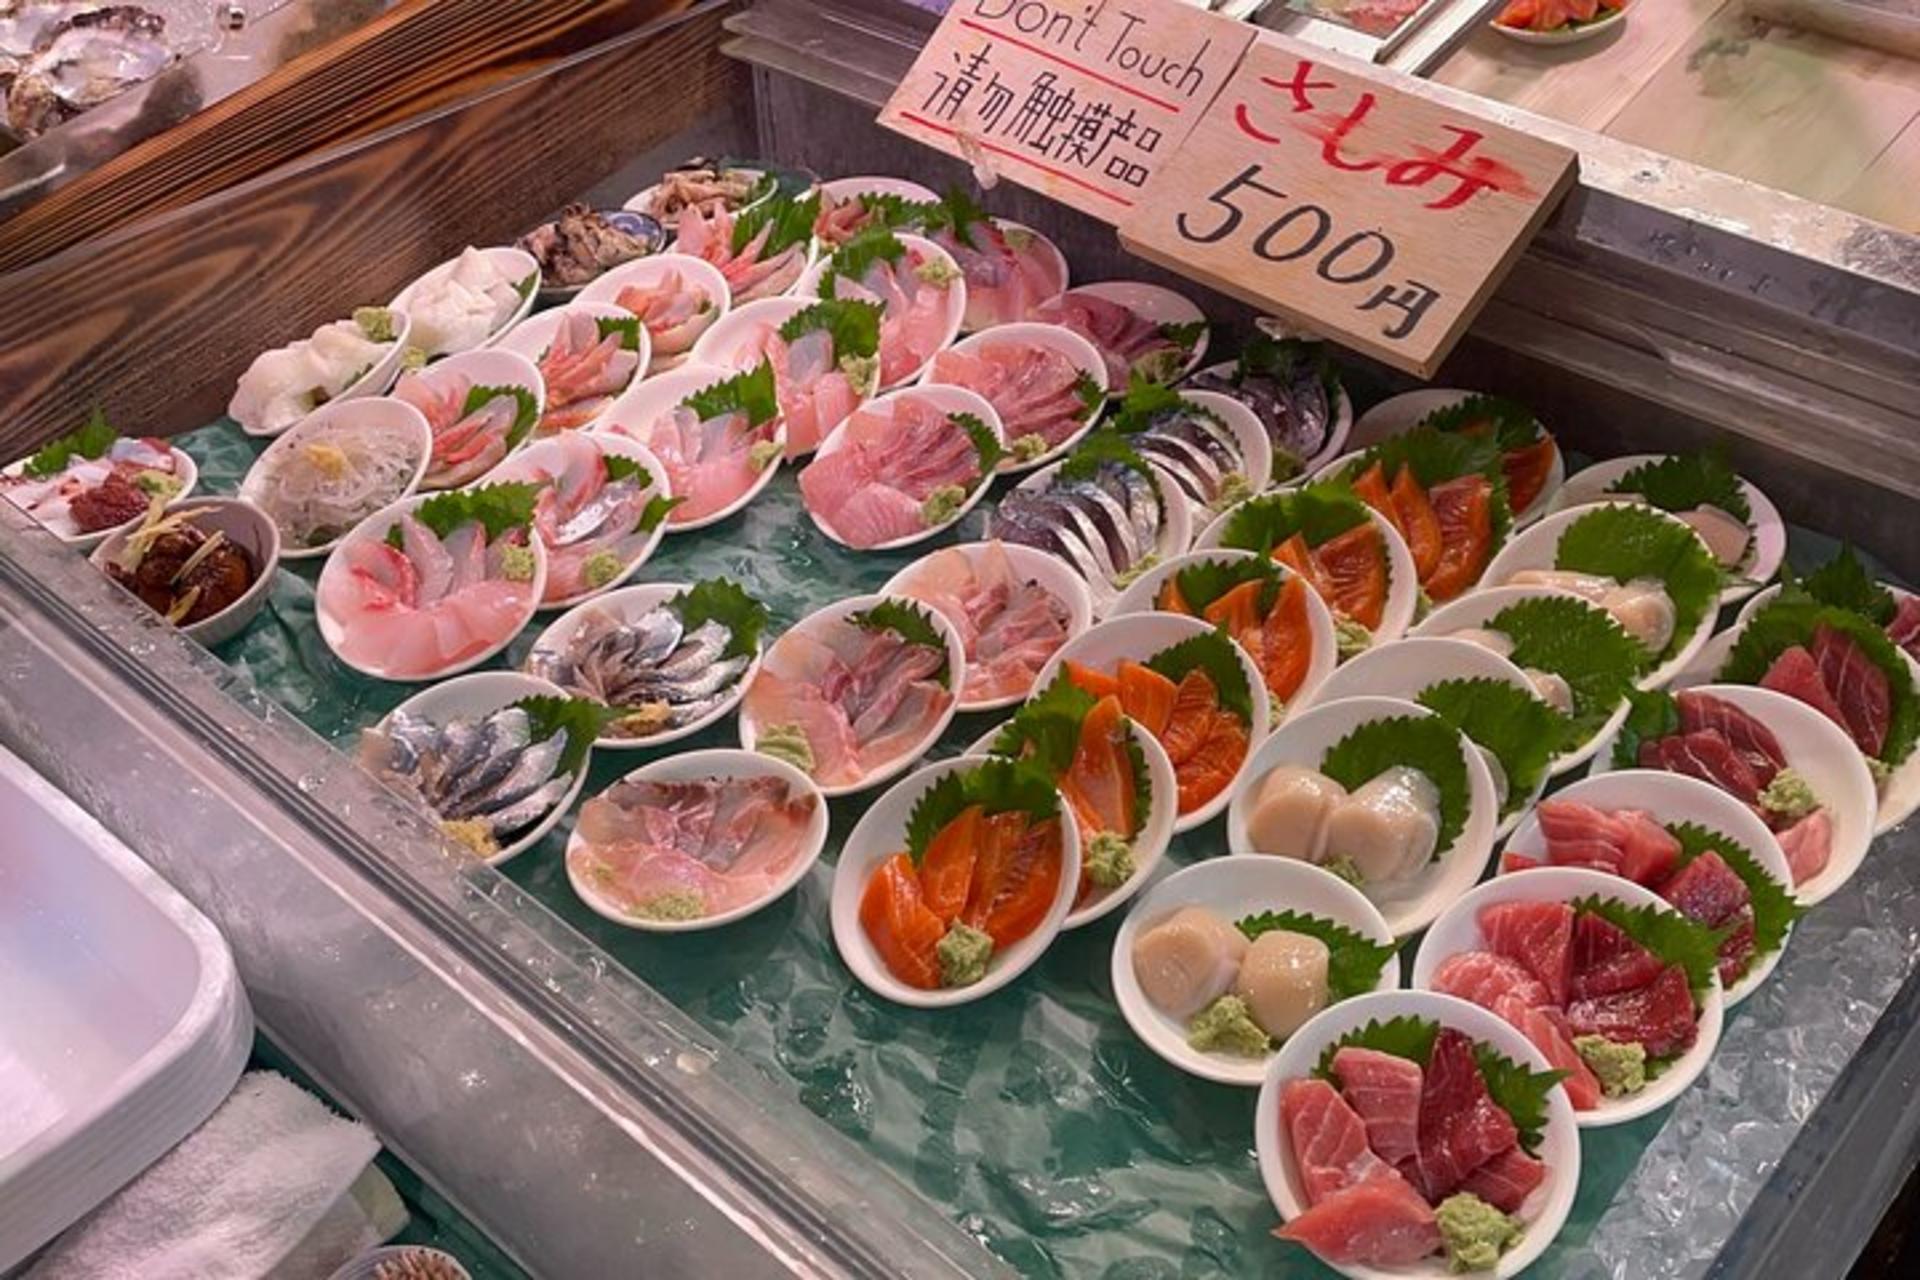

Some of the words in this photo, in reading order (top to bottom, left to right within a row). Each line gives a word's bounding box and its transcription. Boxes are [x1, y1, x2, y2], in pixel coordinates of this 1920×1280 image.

[1106, 11, 1212, 97] Touch
[1235, 61, 1500, 210] さしみ
[1176, 164, 1441, 339] 500円
